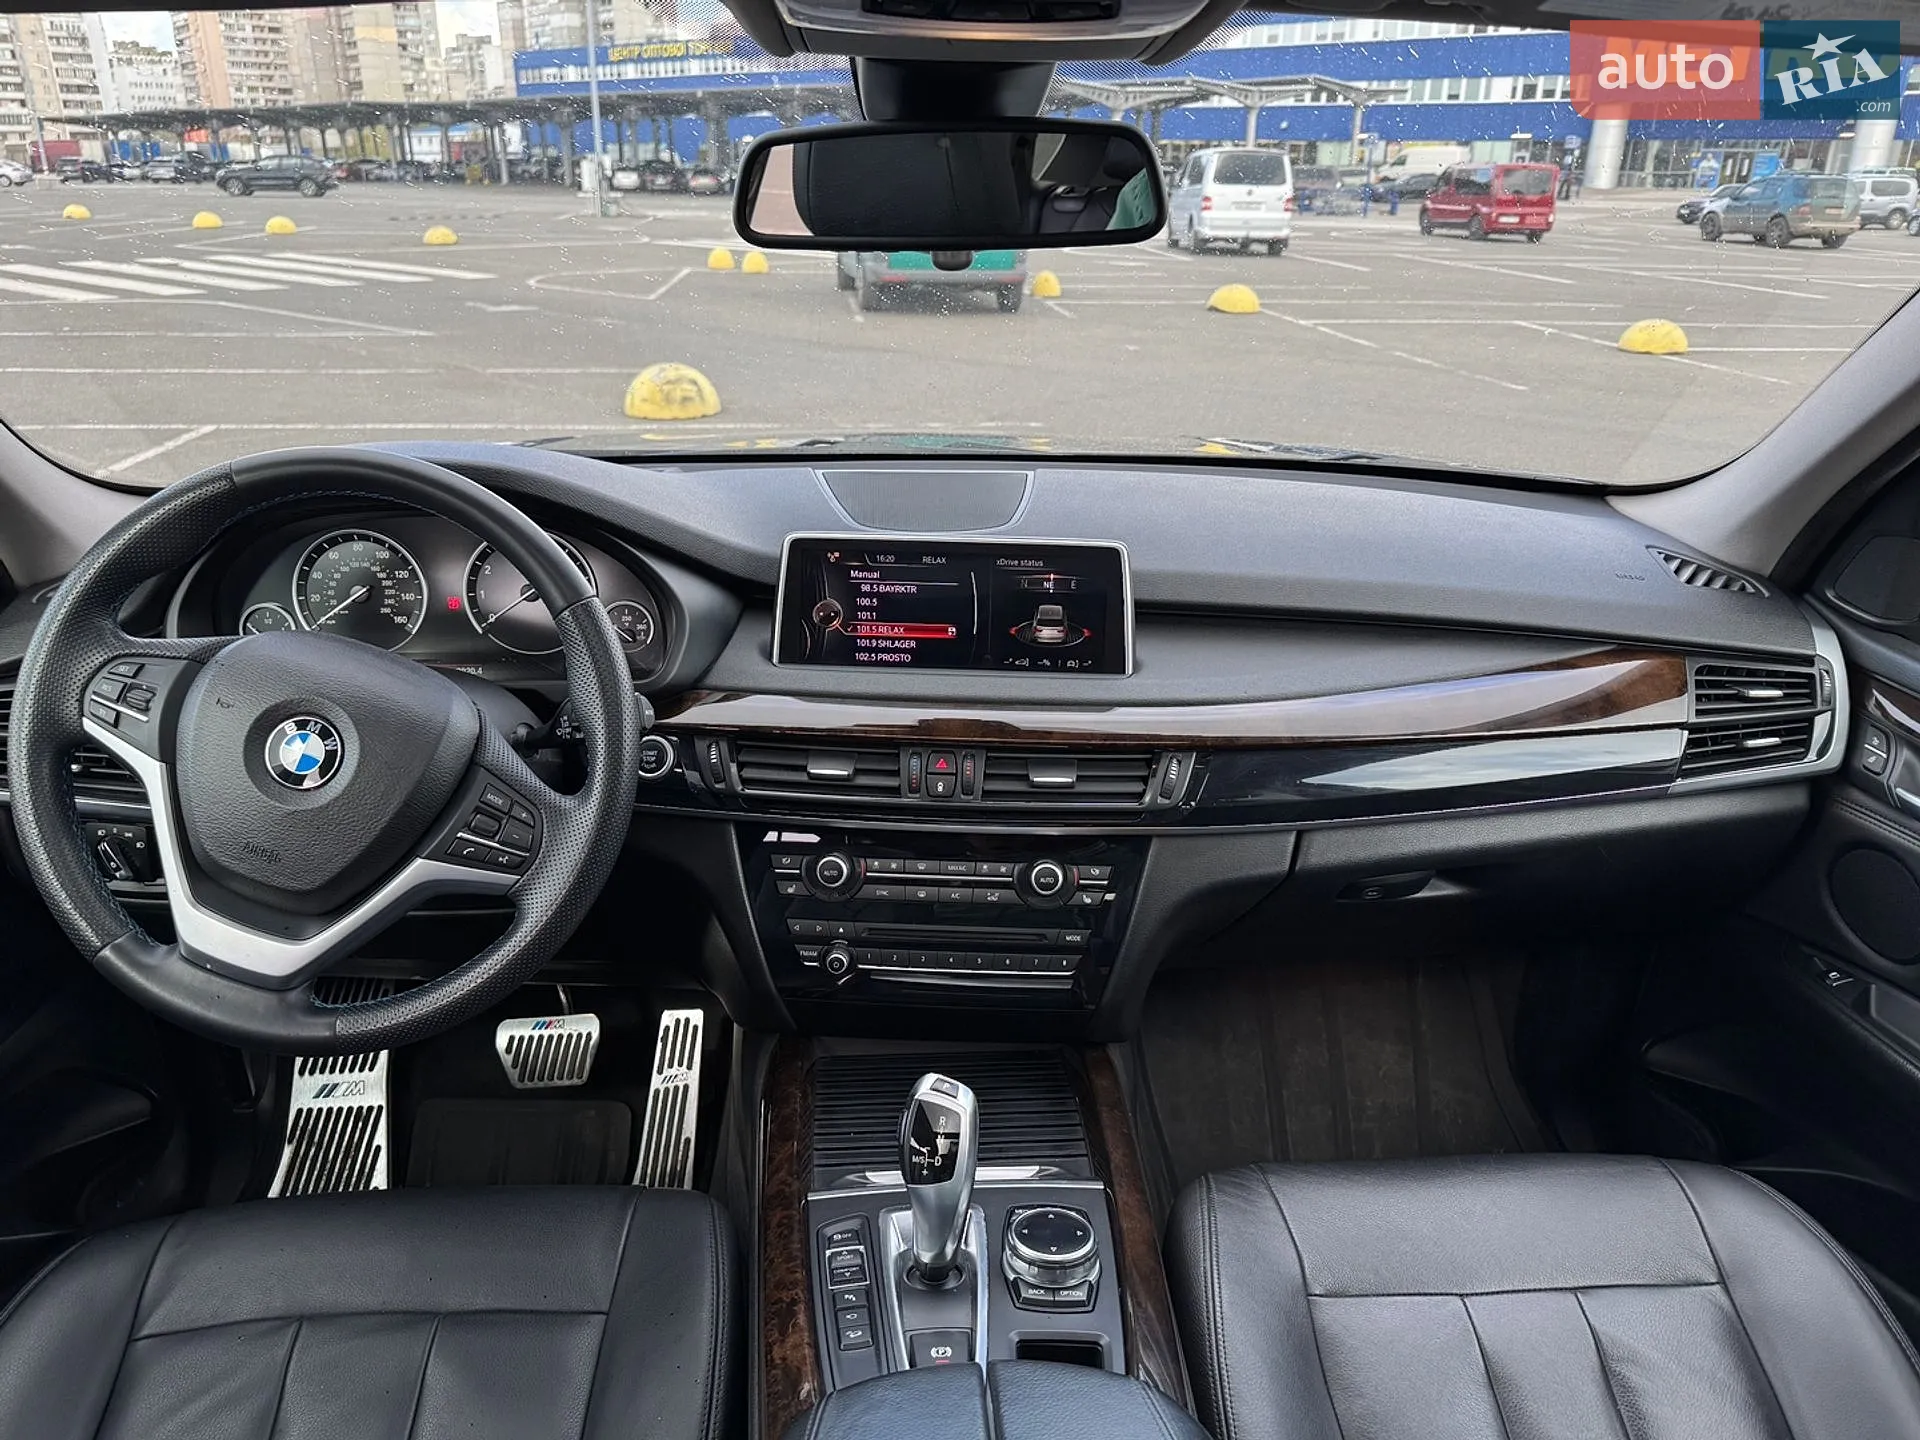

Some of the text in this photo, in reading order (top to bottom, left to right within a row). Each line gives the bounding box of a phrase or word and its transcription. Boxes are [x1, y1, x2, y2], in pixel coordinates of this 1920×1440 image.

[352, 543, 364, 551] 80
[328, 551, 339, 559] 60
[375, 550, 390, 559] 100
[876, 555, 896, 563] 16:20
[922, 556, 947, 564] RELAX
[996, 558, 1044, 567] xDrive status
[394, 570, 409, 579] 120
[485, 566, 492, 575] 2
[850, 570, 880, 579] Manual
[861, 584, 878, 592] 98.5
[1043, 581, 1055, 589] NE
[1070, 580, 1077, 589] E
[310, 594, 321, 602] 20
[401, 593, 415, 601] 140
[856, 598, 878, 606] 100.5
[393, 616, 408, 624] 160
[857, 612, 876, 620] 101.1
[857, 625, 905, 634] 101.5 RELAX
[878, 640, 916, 649] SHLAGER
[878, 653, 912, 662] PROSTO
[284, 721, 337, 750] BMW
[939, 1116, 946, 1126] R
[934, 1156, 942, 1166] D
